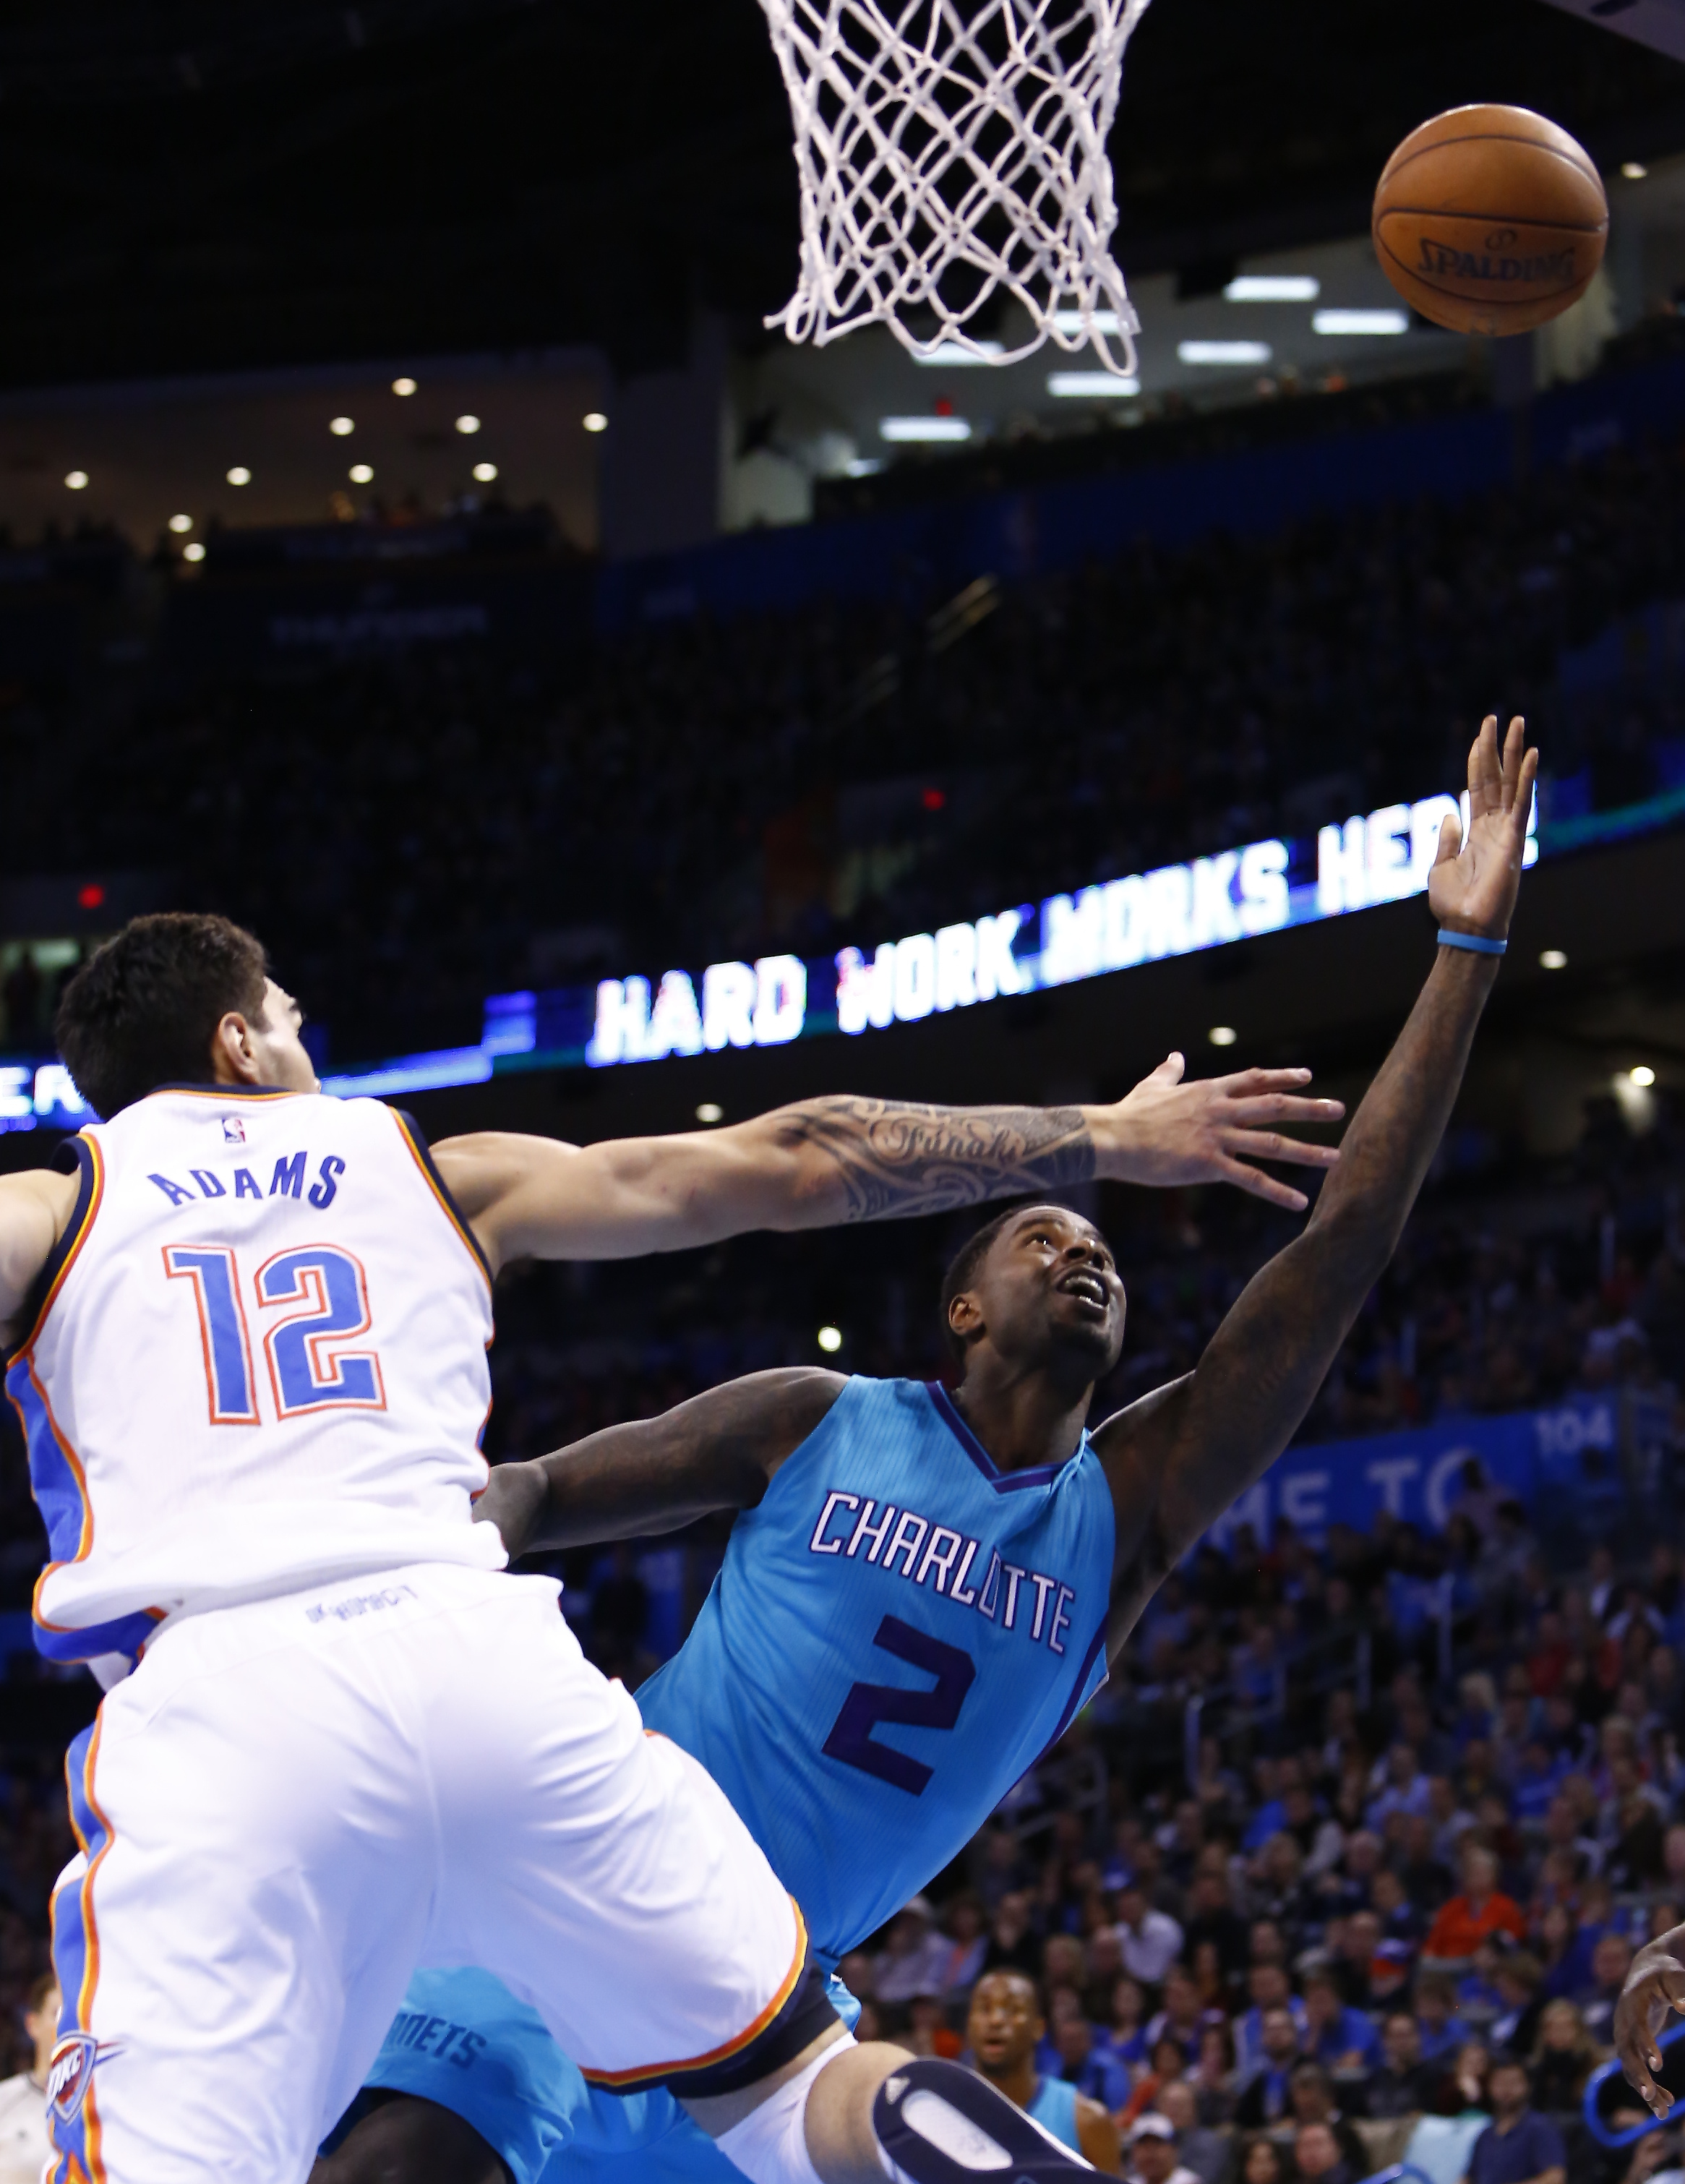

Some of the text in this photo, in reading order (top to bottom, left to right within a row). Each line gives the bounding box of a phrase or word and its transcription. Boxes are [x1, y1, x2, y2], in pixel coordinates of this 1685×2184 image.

[1418, 238, 1576, 281] SPALDING
[590, 954, 807, 1067] HARD
[147, 1151, 346, 1209] ADAMS
[161, 1243, 388, 1426] 12
[808, 1488, 1076, 1659] CHARLOTTE
[820, 1613, 977, 1797] 2
